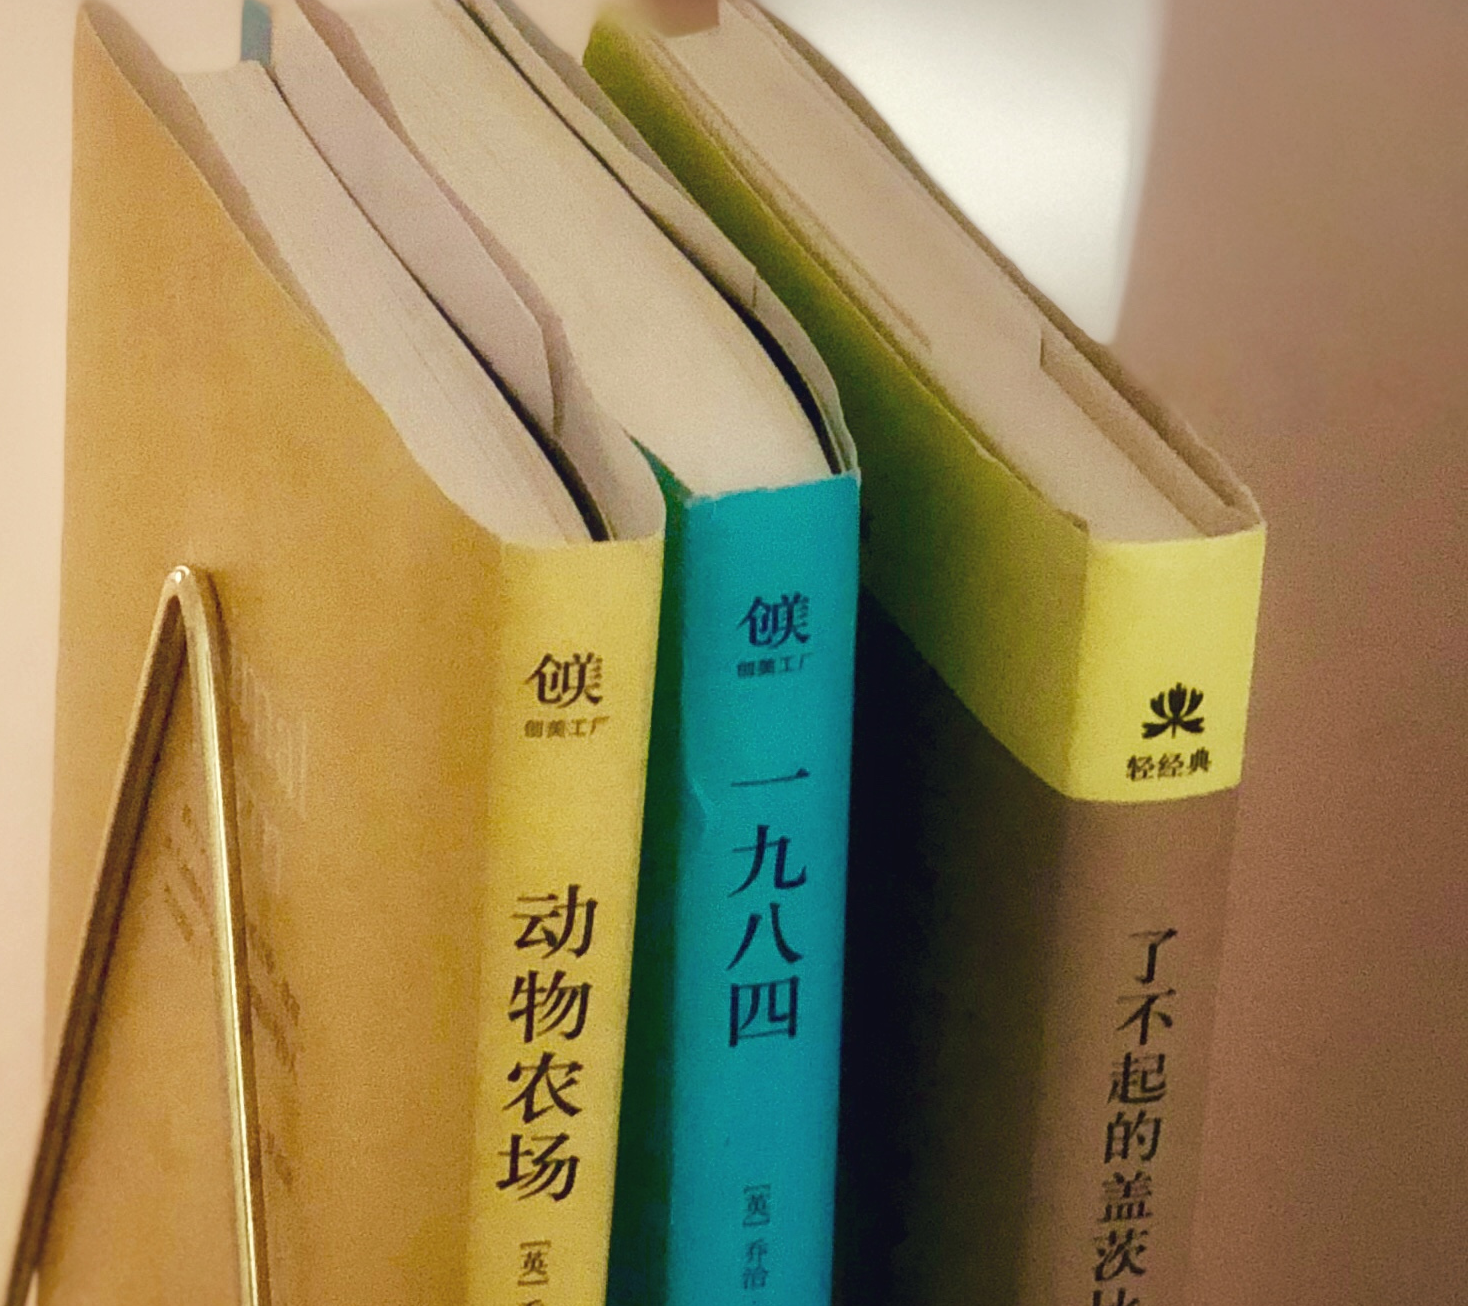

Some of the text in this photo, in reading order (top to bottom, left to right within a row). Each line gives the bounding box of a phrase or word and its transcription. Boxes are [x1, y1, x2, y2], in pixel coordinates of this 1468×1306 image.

[1126, 747, 1212, 783] 轻经典
[495, 883, 599, 1203] 动物农场
[727, 767, 811, 1048] 一九八四
